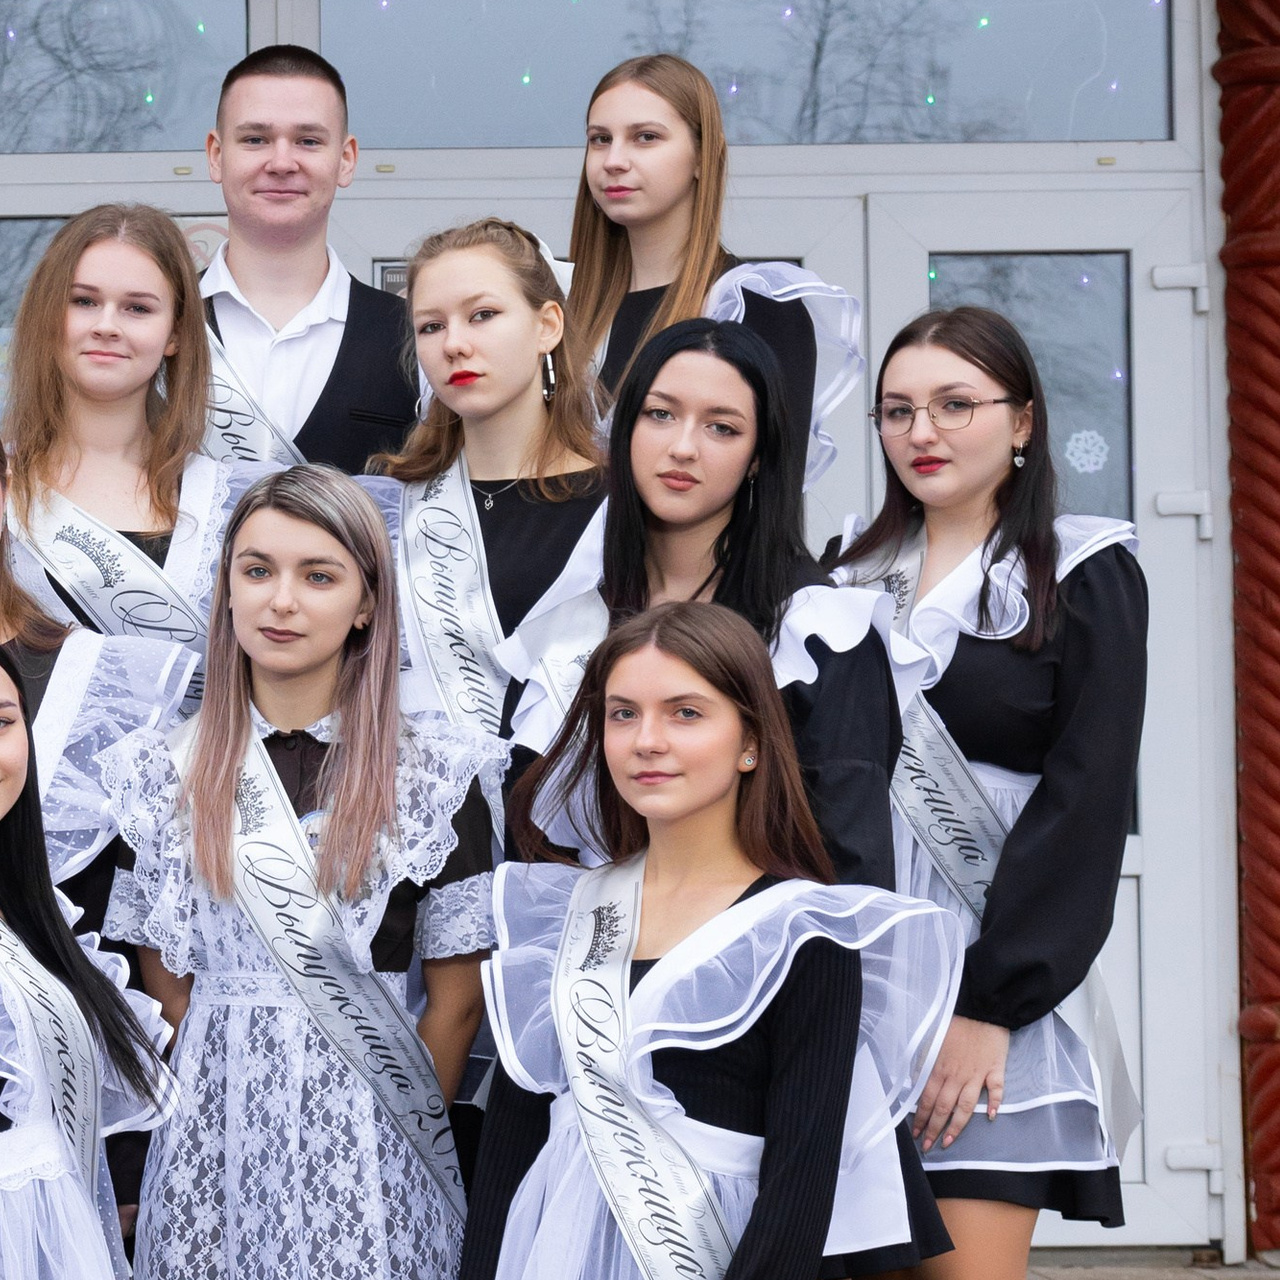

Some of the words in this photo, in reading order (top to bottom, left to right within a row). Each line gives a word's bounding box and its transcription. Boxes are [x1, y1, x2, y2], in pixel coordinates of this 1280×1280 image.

[238, 841, 415, 1095] Выпускница
[385, 1021, 432, 1089] Владимировна
[659, 1143, 688, 1195] Алина
